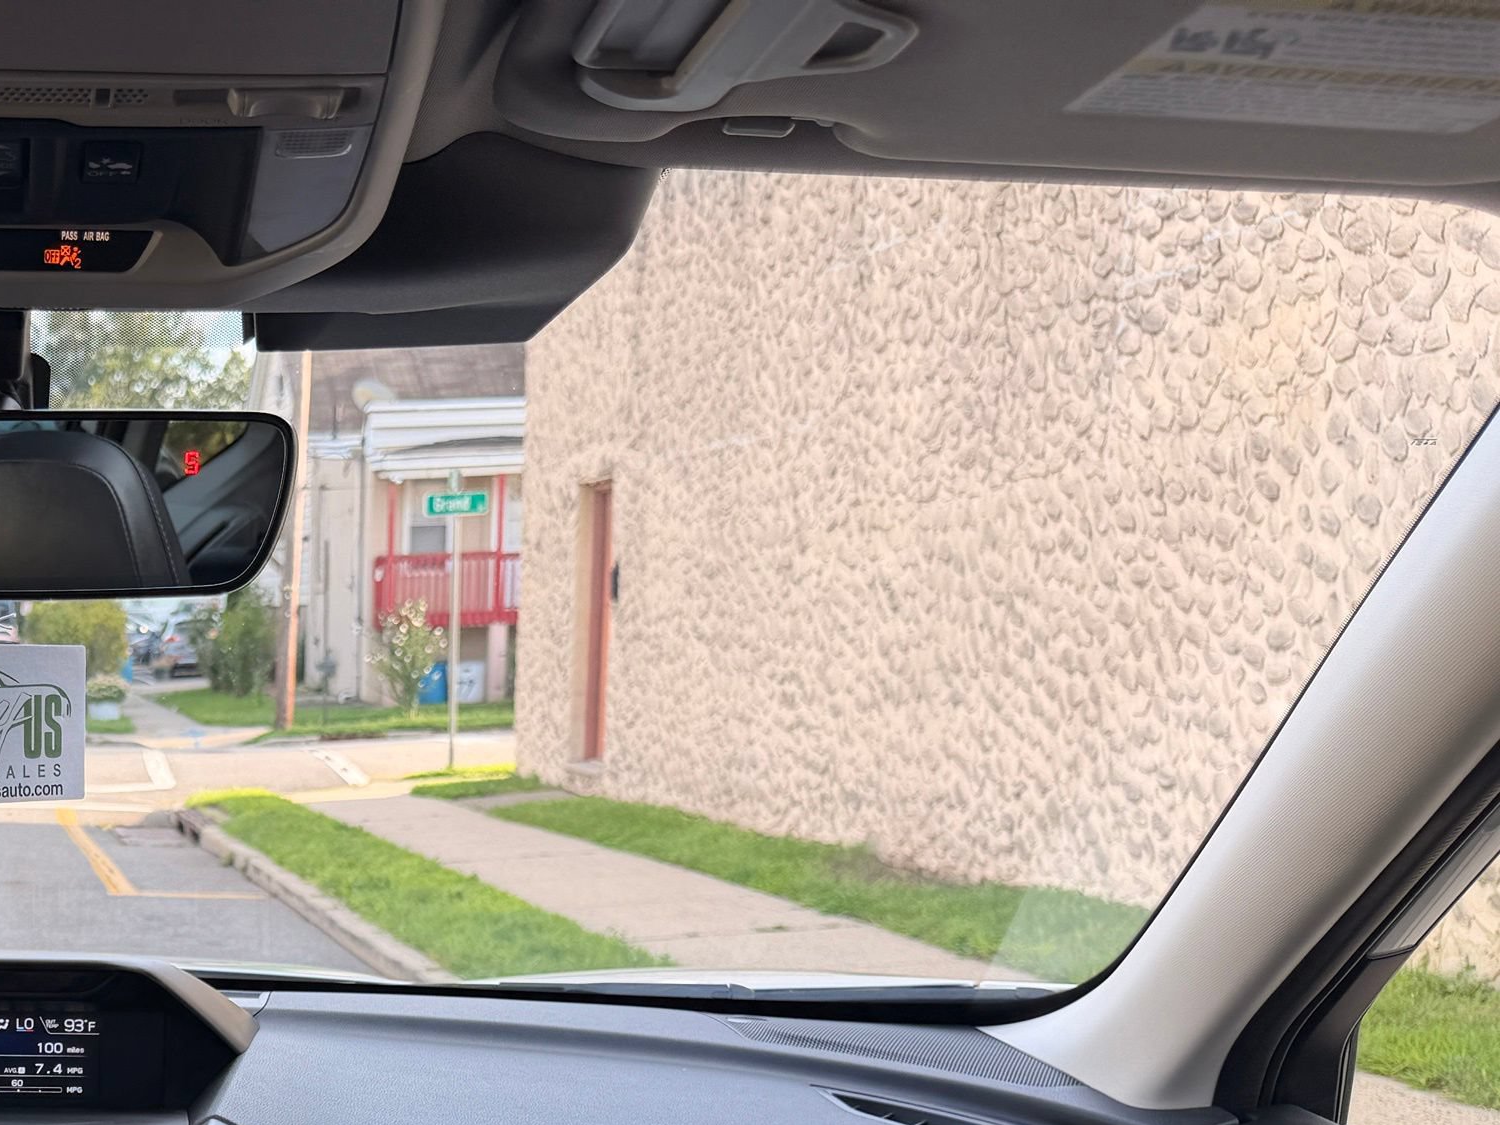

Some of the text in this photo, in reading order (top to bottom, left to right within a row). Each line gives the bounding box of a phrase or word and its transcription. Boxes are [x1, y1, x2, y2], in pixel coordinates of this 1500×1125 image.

[61, 230, 110, 242] PASS AIR BAG
[23, 694, 63, 759] US
[16, 1017, 34, 1030] LO
[36, 1042, 85, 1054] 100 miles
[66, 1066, 84, 1074] MPG
[11, 1078, 24, 1088] 60
[66, 1086, 83, 1094] MPG
